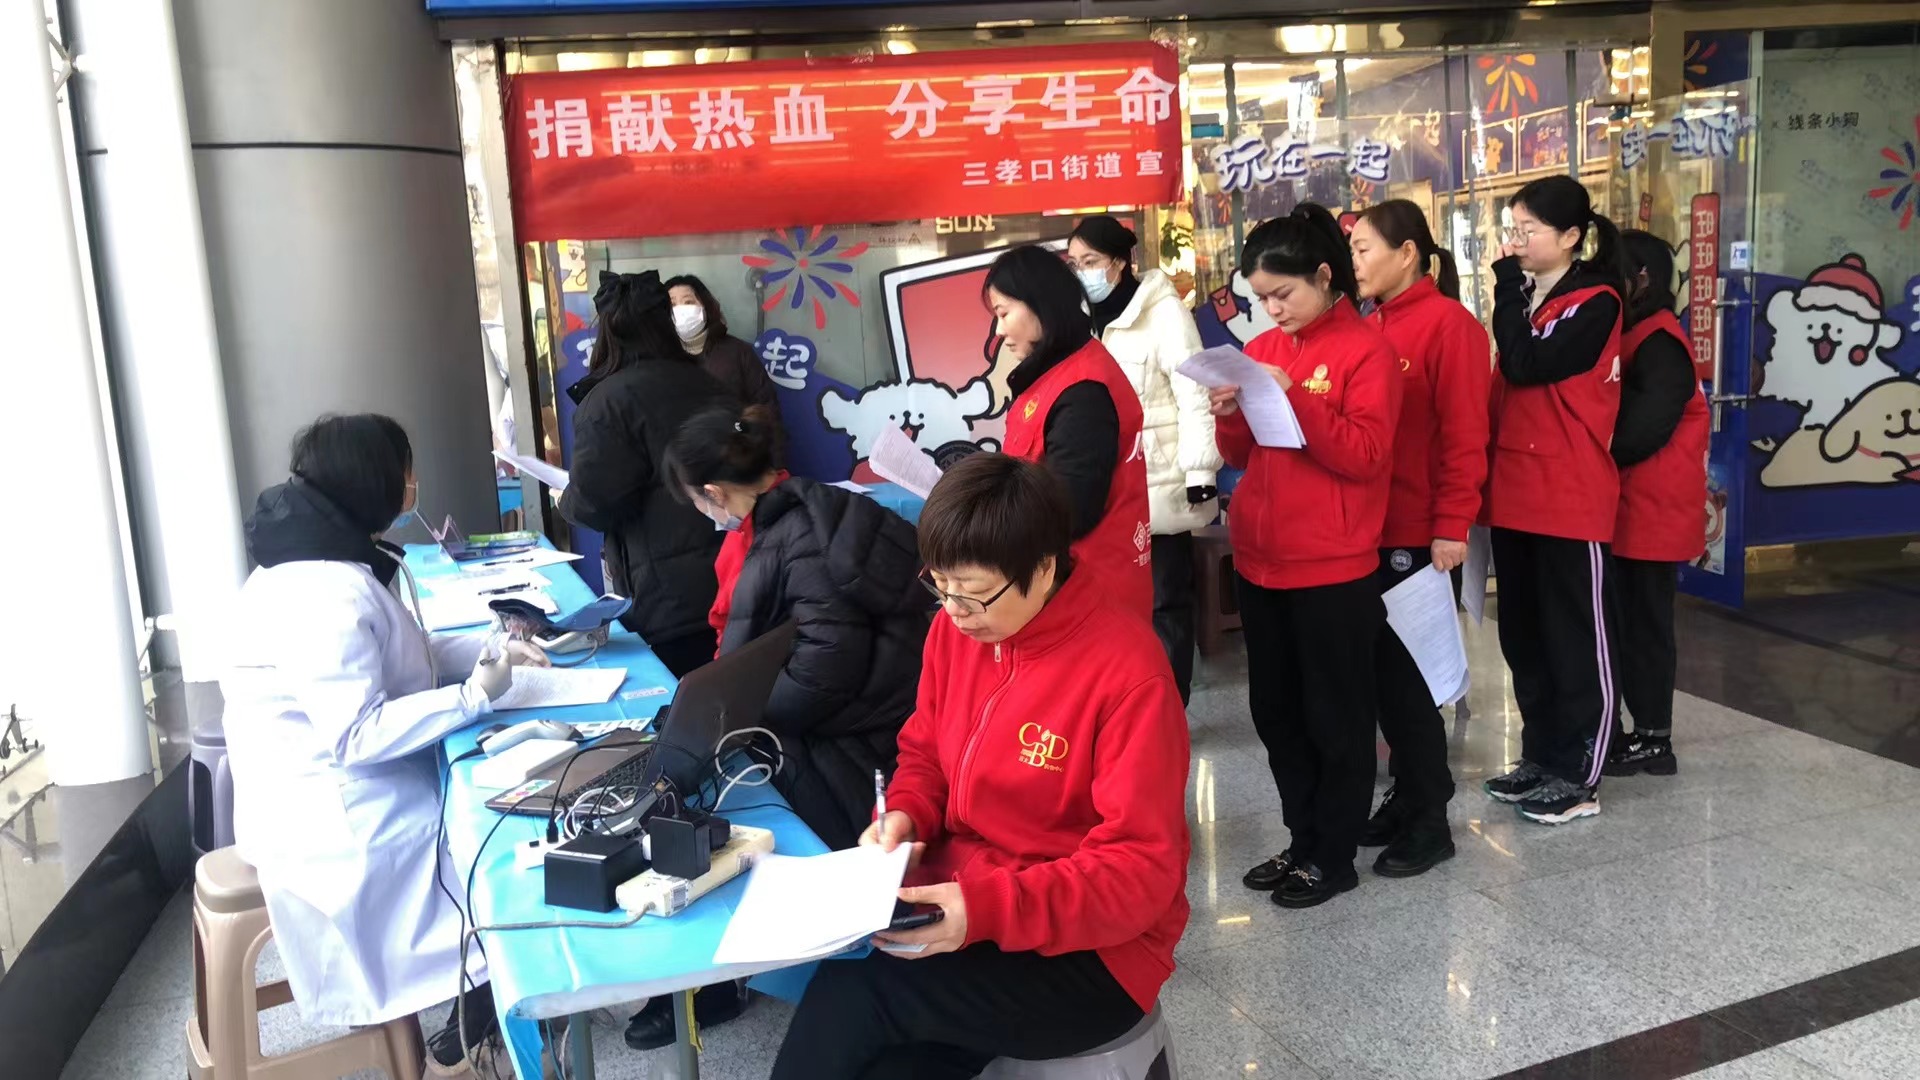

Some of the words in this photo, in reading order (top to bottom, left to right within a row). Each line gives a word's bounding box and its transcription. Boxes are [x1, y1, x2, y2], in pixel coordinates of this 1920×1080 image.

[525, 84, 836, 159] 捐献热血
[885, 67, 1178, 140] 分享生命
[962, 152, 1123, 186] 三孝口街道
[1136, 150, 1164, 176] 宣
[1212, 134, 1391, 192] 玩在一起
